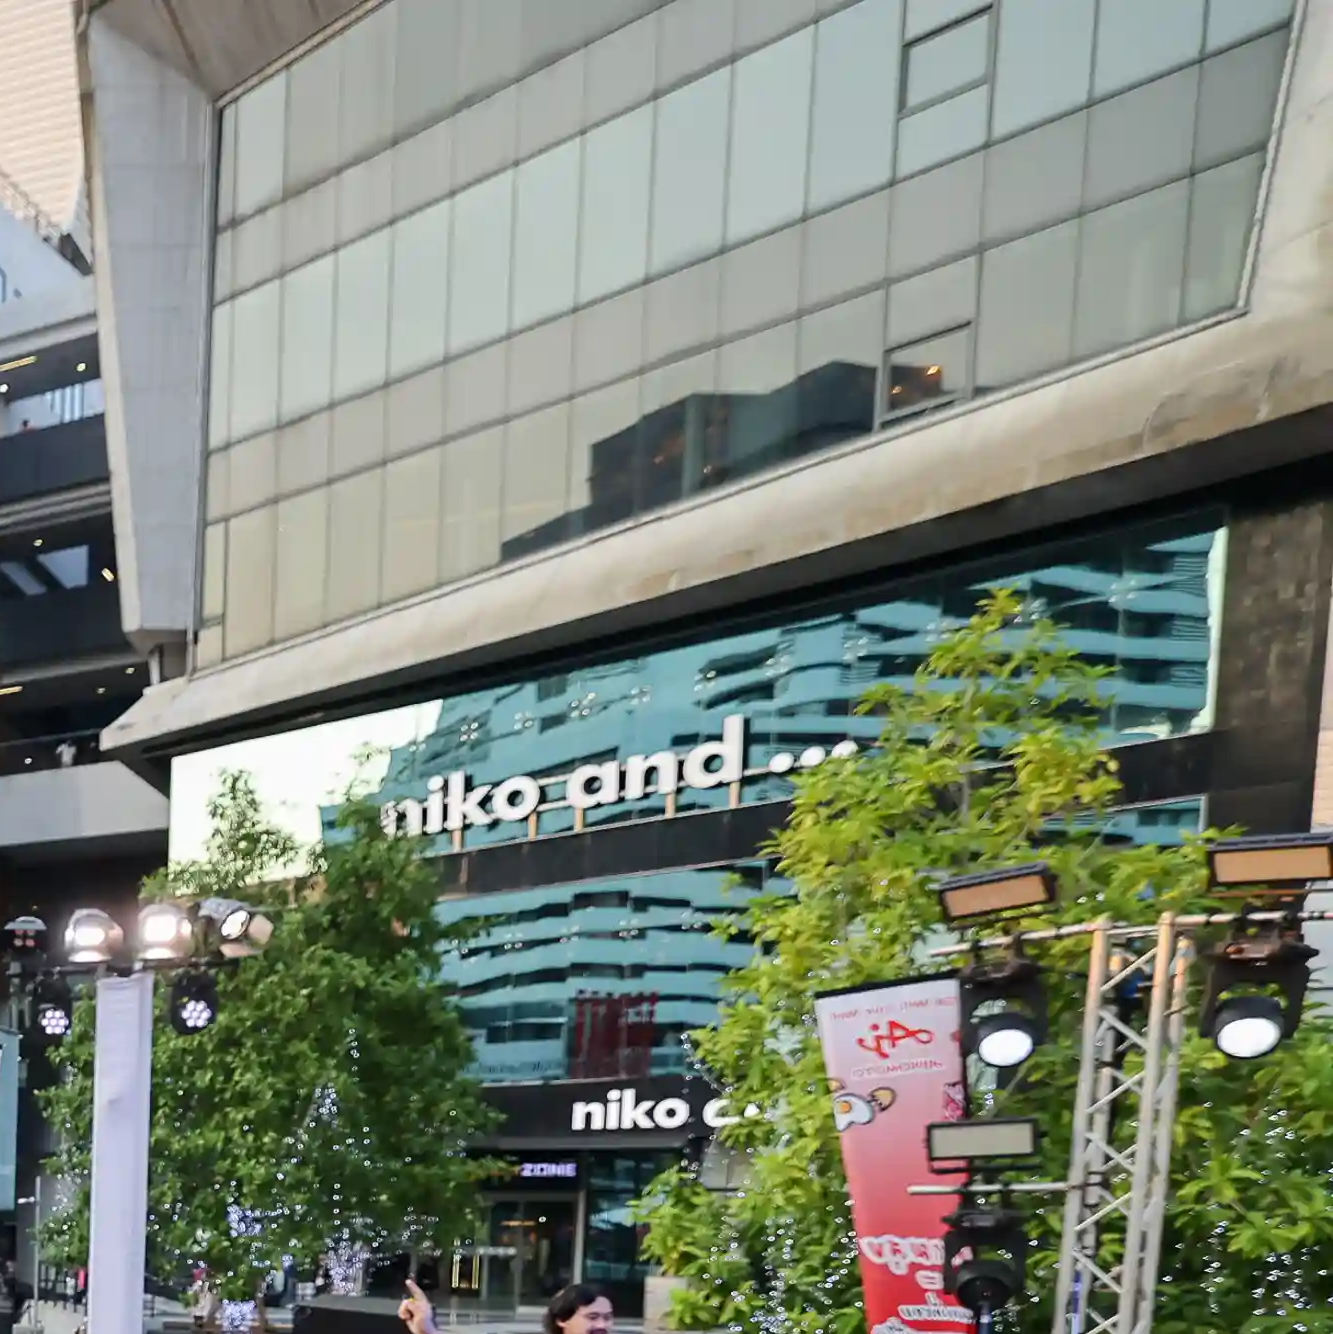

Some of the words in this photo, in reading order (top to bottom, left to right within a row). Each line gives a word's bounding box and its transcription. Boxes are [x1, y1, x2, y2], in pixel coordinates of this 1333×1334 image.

[380, 769, 541, 838] niko
[566, 714, 744, 809] and
[571, 1088, 691, 1131] niko
